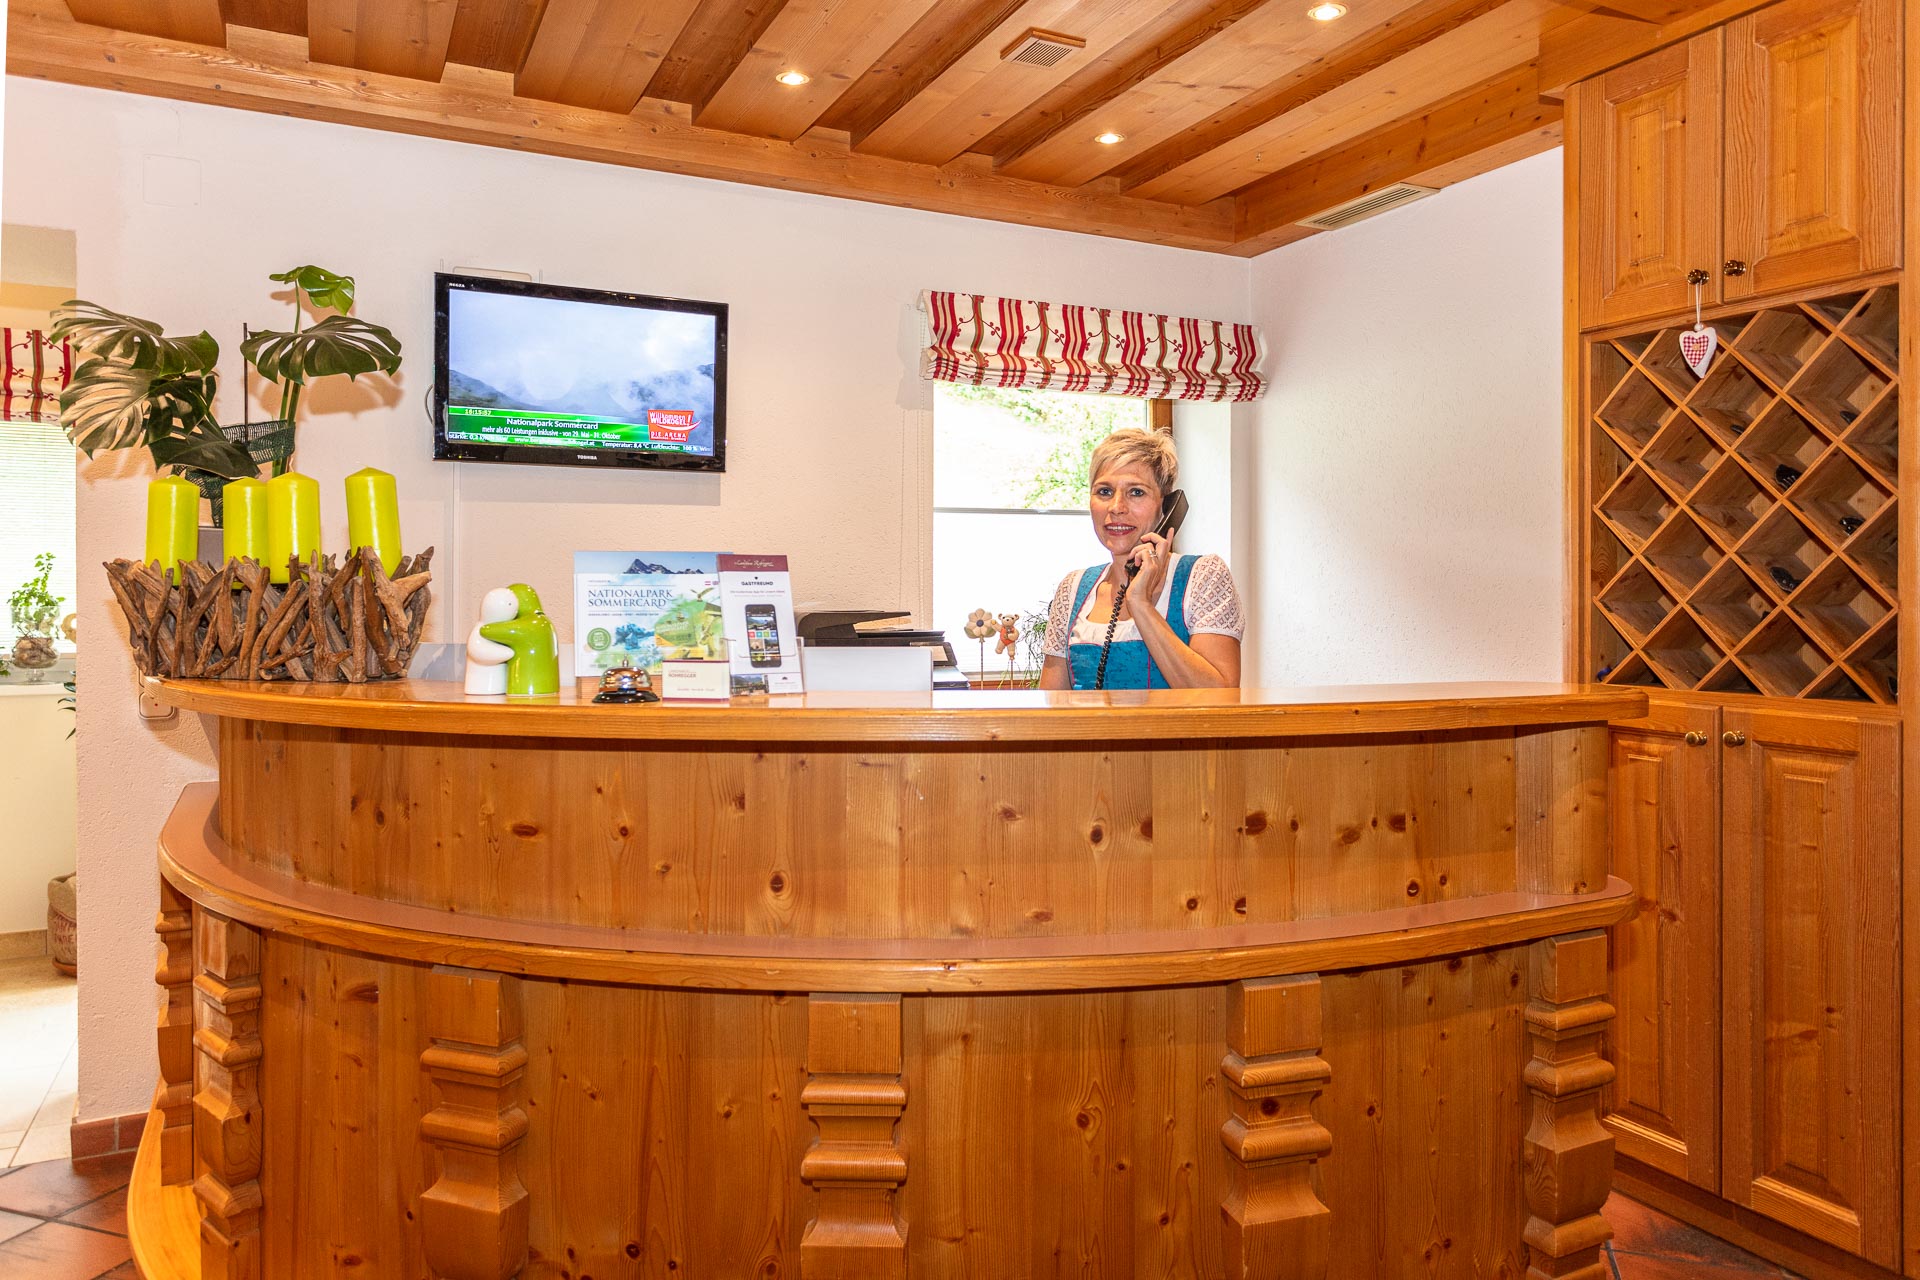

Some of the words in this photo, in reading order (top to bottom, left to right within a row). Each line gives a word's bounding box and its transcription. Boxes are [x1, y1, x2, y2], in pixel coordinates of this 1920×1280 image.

[506, 418, 553, 427] Nationalpark
[554, 421, 598, 429] Sommercard
[511, 428, 538, 436] Leistungen
[538, 428, 559, 437] inklusive
[601, 432, 621, 440] Oktober
[588, 589, 674, 600] NATIONALPARK
[588, 598, 668, 609] SOMMERCARD
